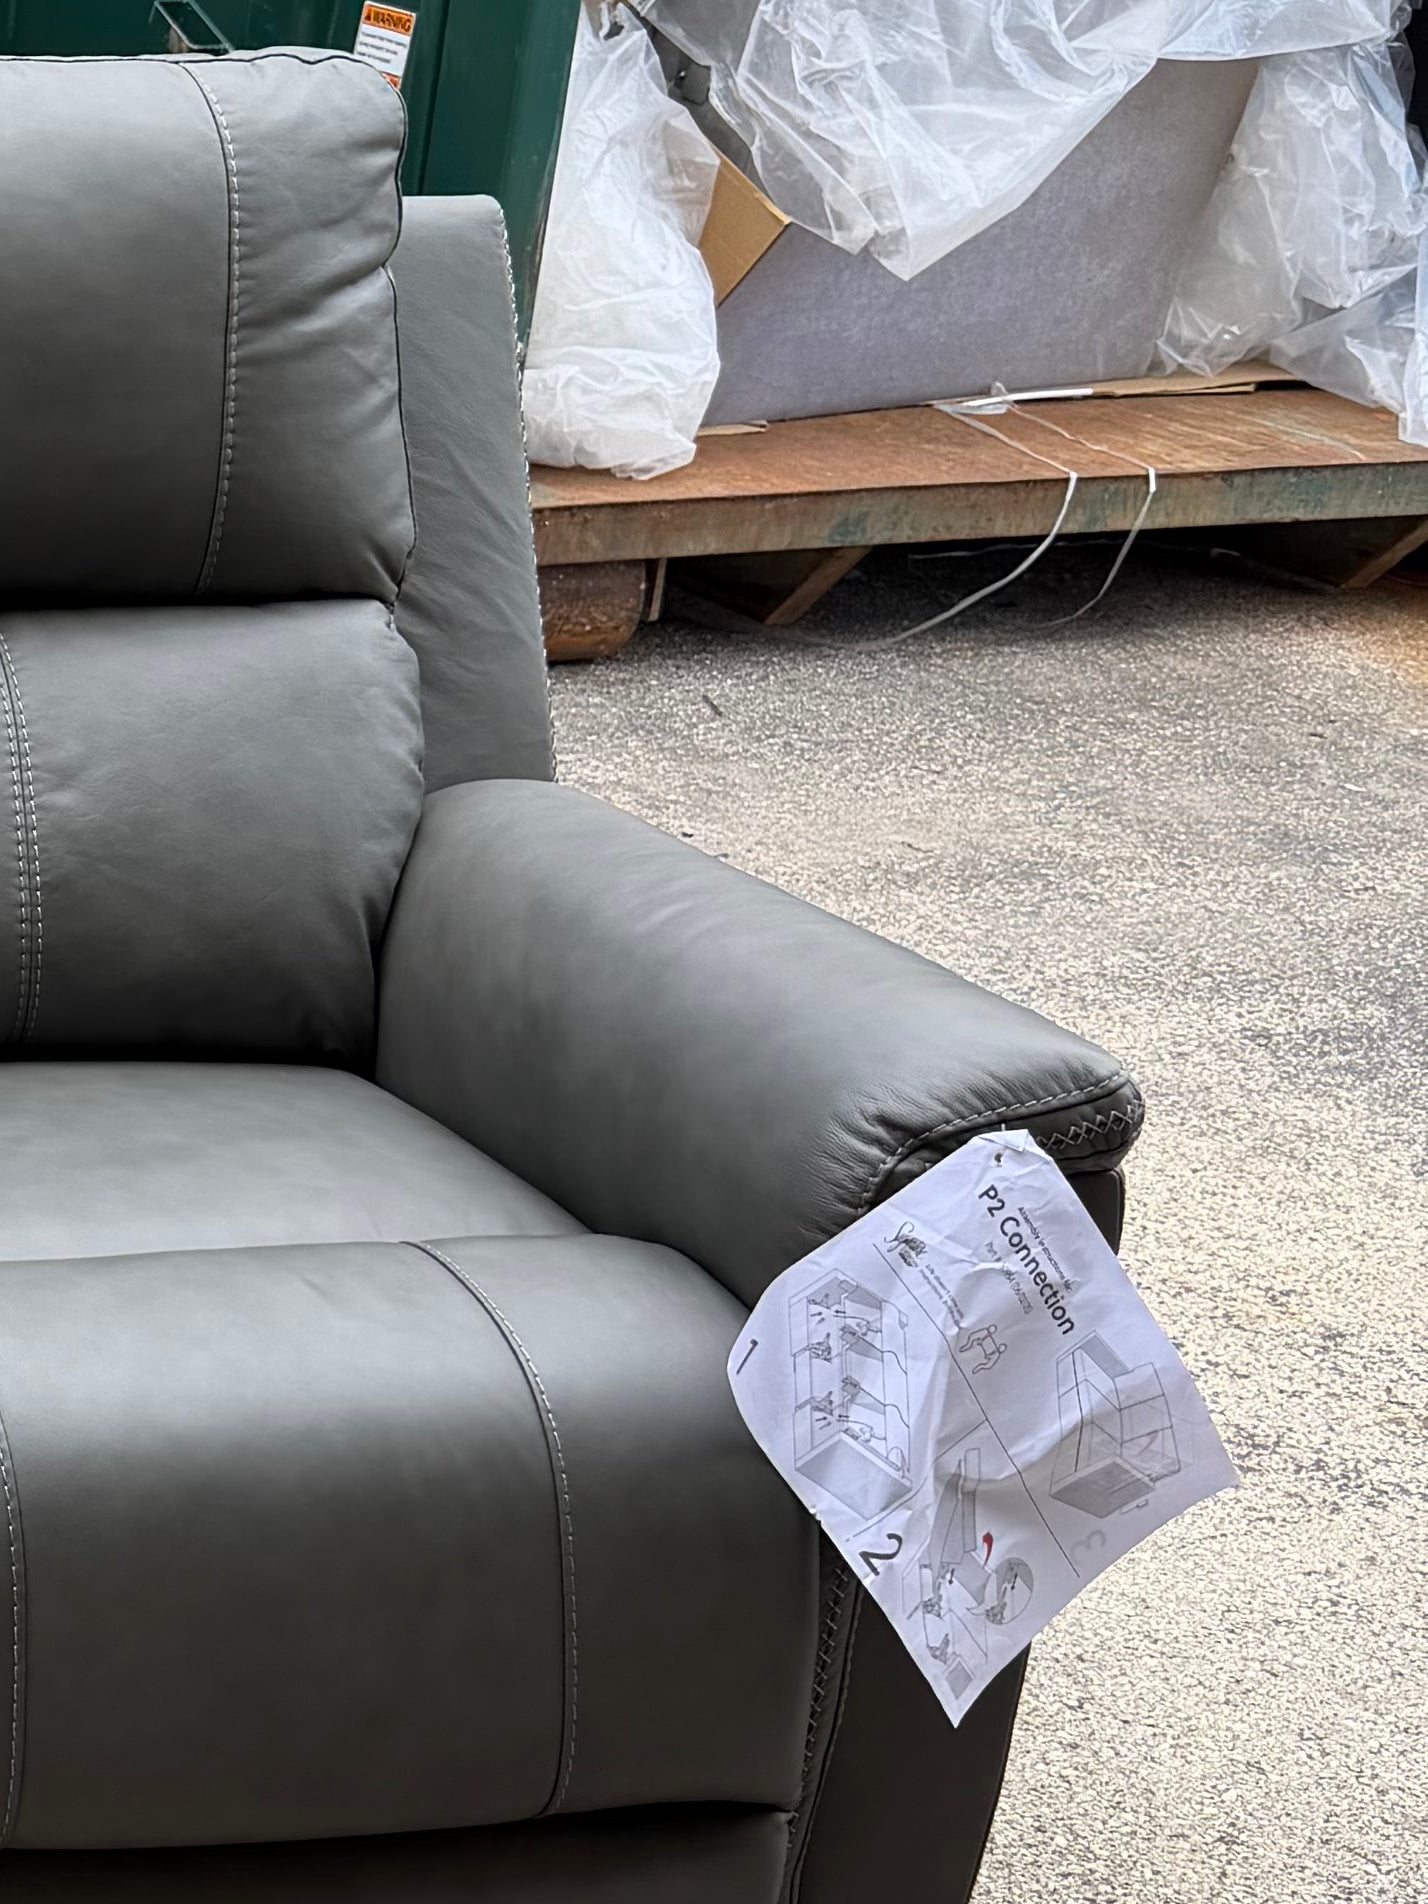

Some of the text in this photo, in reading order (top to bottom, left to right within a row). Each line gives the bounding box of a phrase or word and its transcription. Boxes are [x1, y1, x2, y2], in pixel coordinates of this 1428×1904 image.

[372, 9, 412, 33] WARNING
[978, 1184, 1005, 1218] P2
[1000, 1216, 1075, 1335] Connection
[736, 1339, 759, 1375] 1
[858, 1532, 903, 1577] 2
[1069, 1529, 1107, 1565] 3
